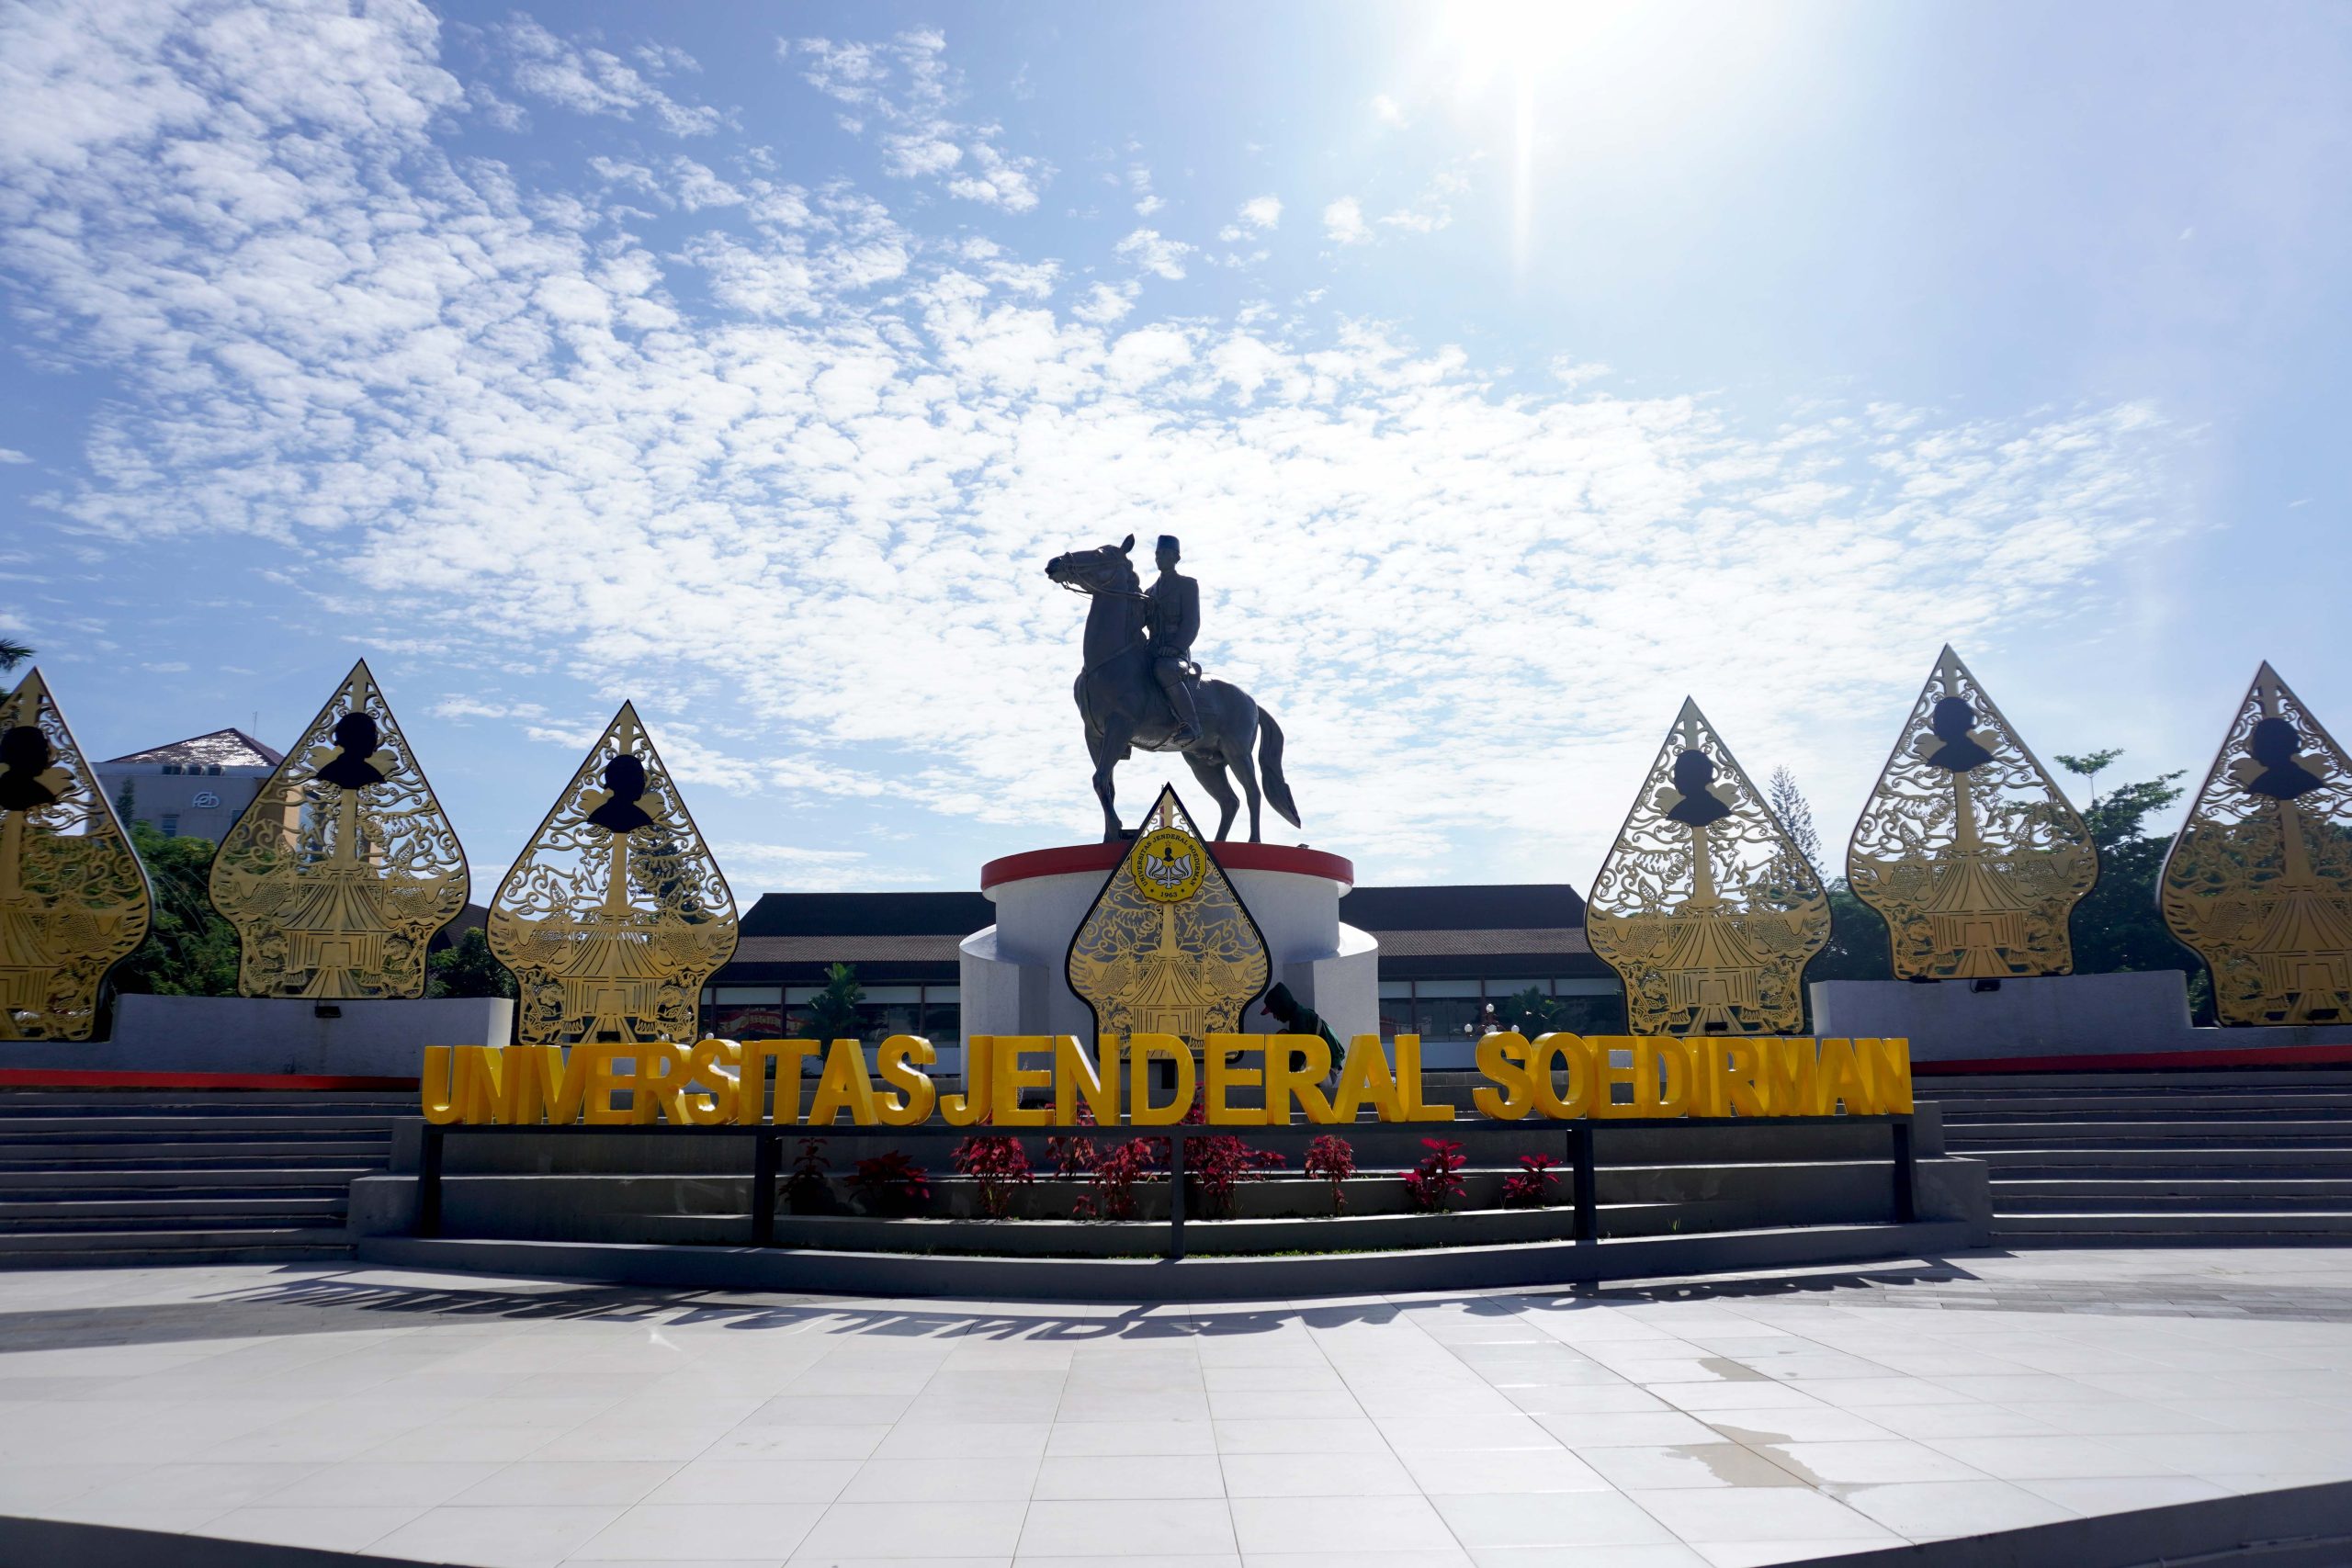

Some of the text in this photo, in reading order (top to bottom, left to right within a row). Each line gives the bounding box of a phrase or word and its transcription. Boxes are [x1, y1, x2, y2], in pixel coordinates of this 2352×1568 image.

[1136, 833, 1201, 886] UNIVERSITAS JENDERAL SOEDIRMAN
[422, 1032, 1914, 1127] UNIVERSITAS JENDERAL SOEDIRMAN
